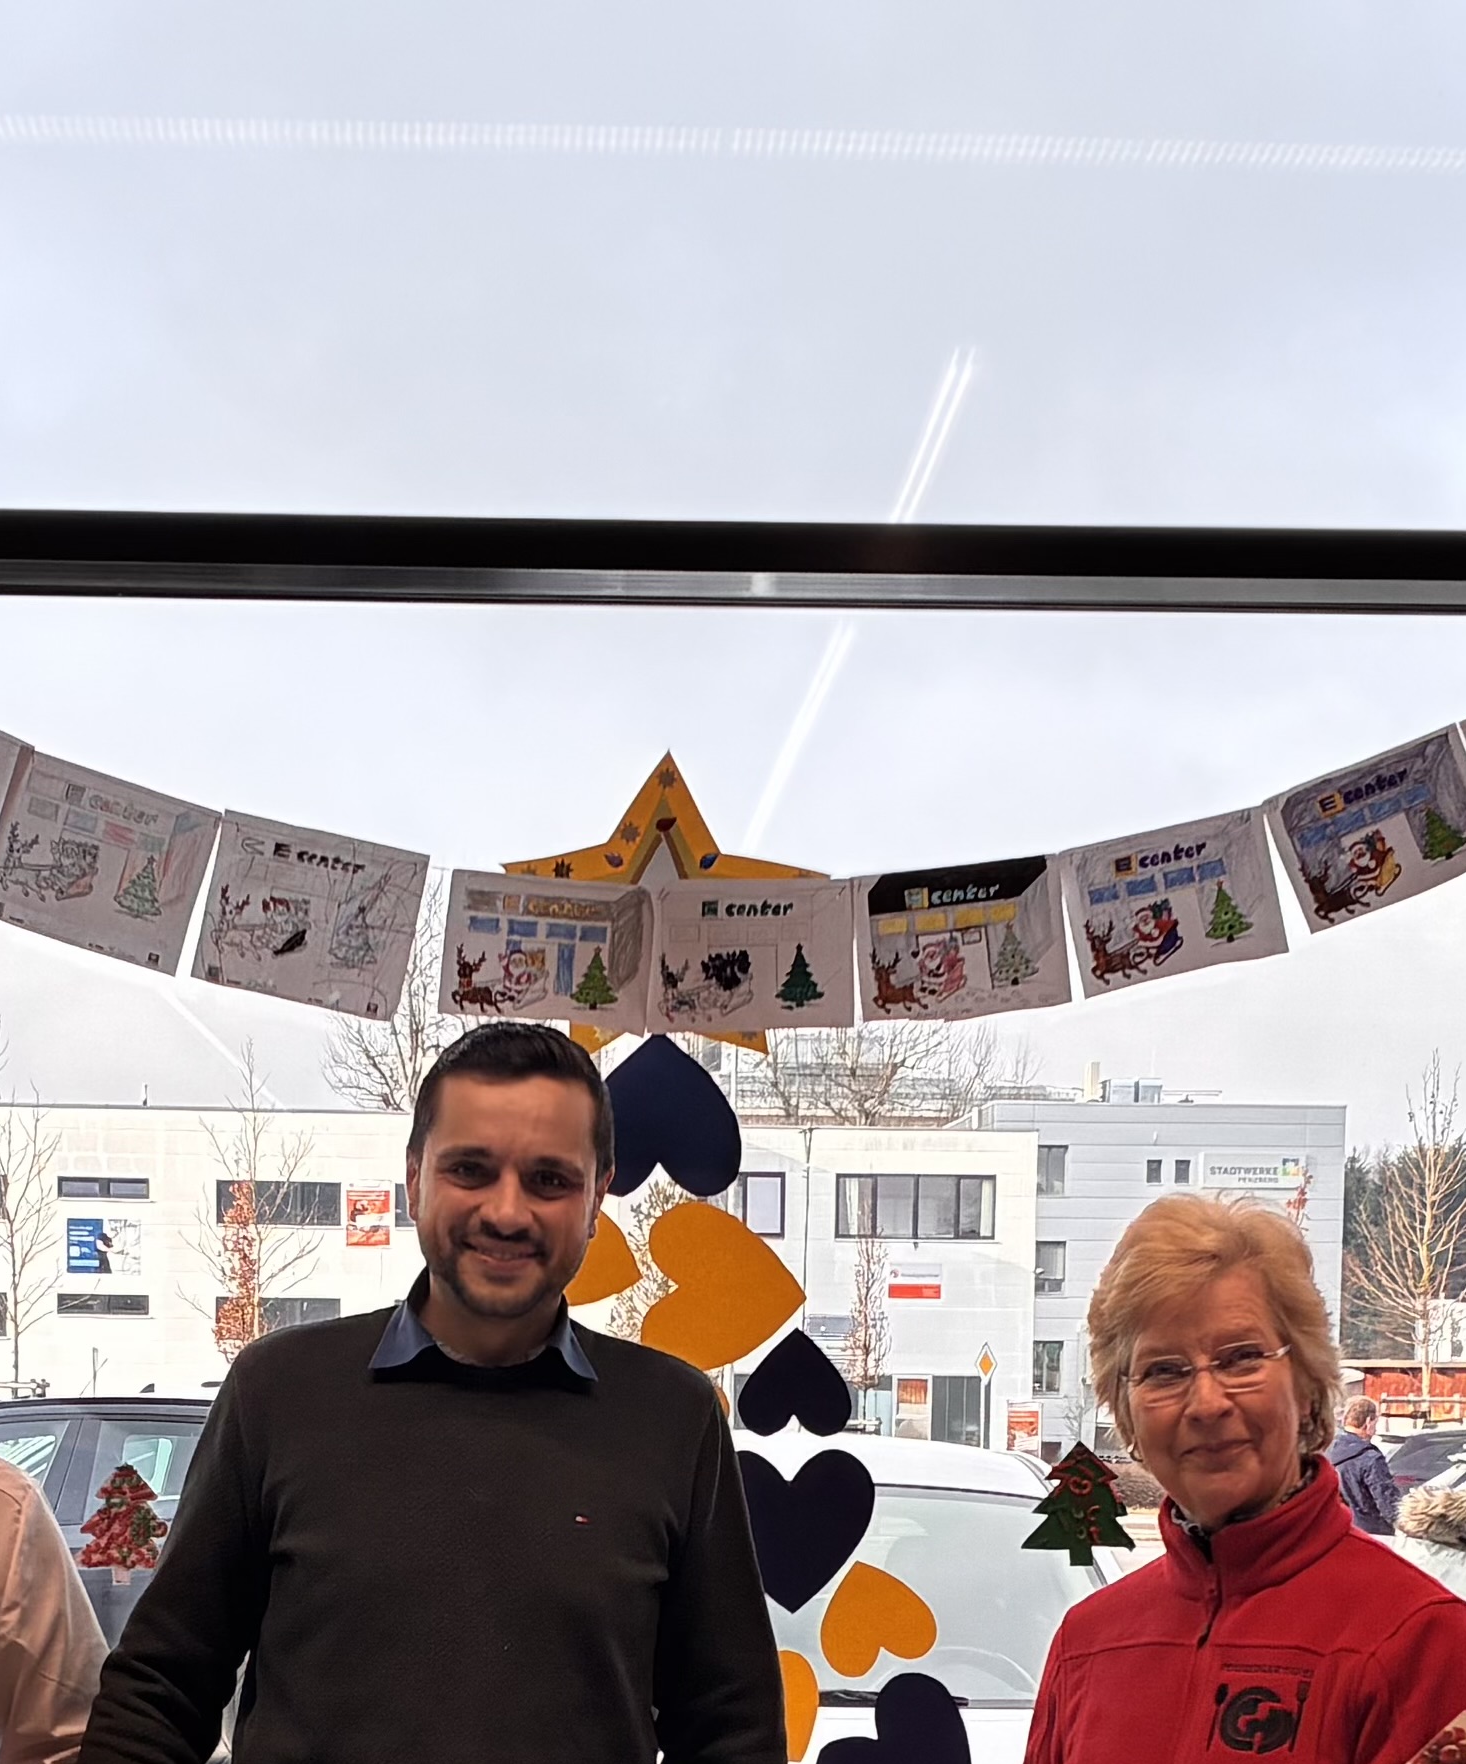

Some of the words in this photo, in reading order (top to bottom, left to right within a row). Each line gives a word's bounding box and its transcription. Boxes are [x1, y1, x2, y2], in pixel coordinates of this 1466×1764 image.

[1344, 768, 1409, 802] center
[297, 848, 366, 874] center
[1138, 841, 1207, 869] center
[931, 884, 1000, 905] center
[725, 901, 794, 918] center
[1209, 1166, 1278, 1176] STADTWERKE
